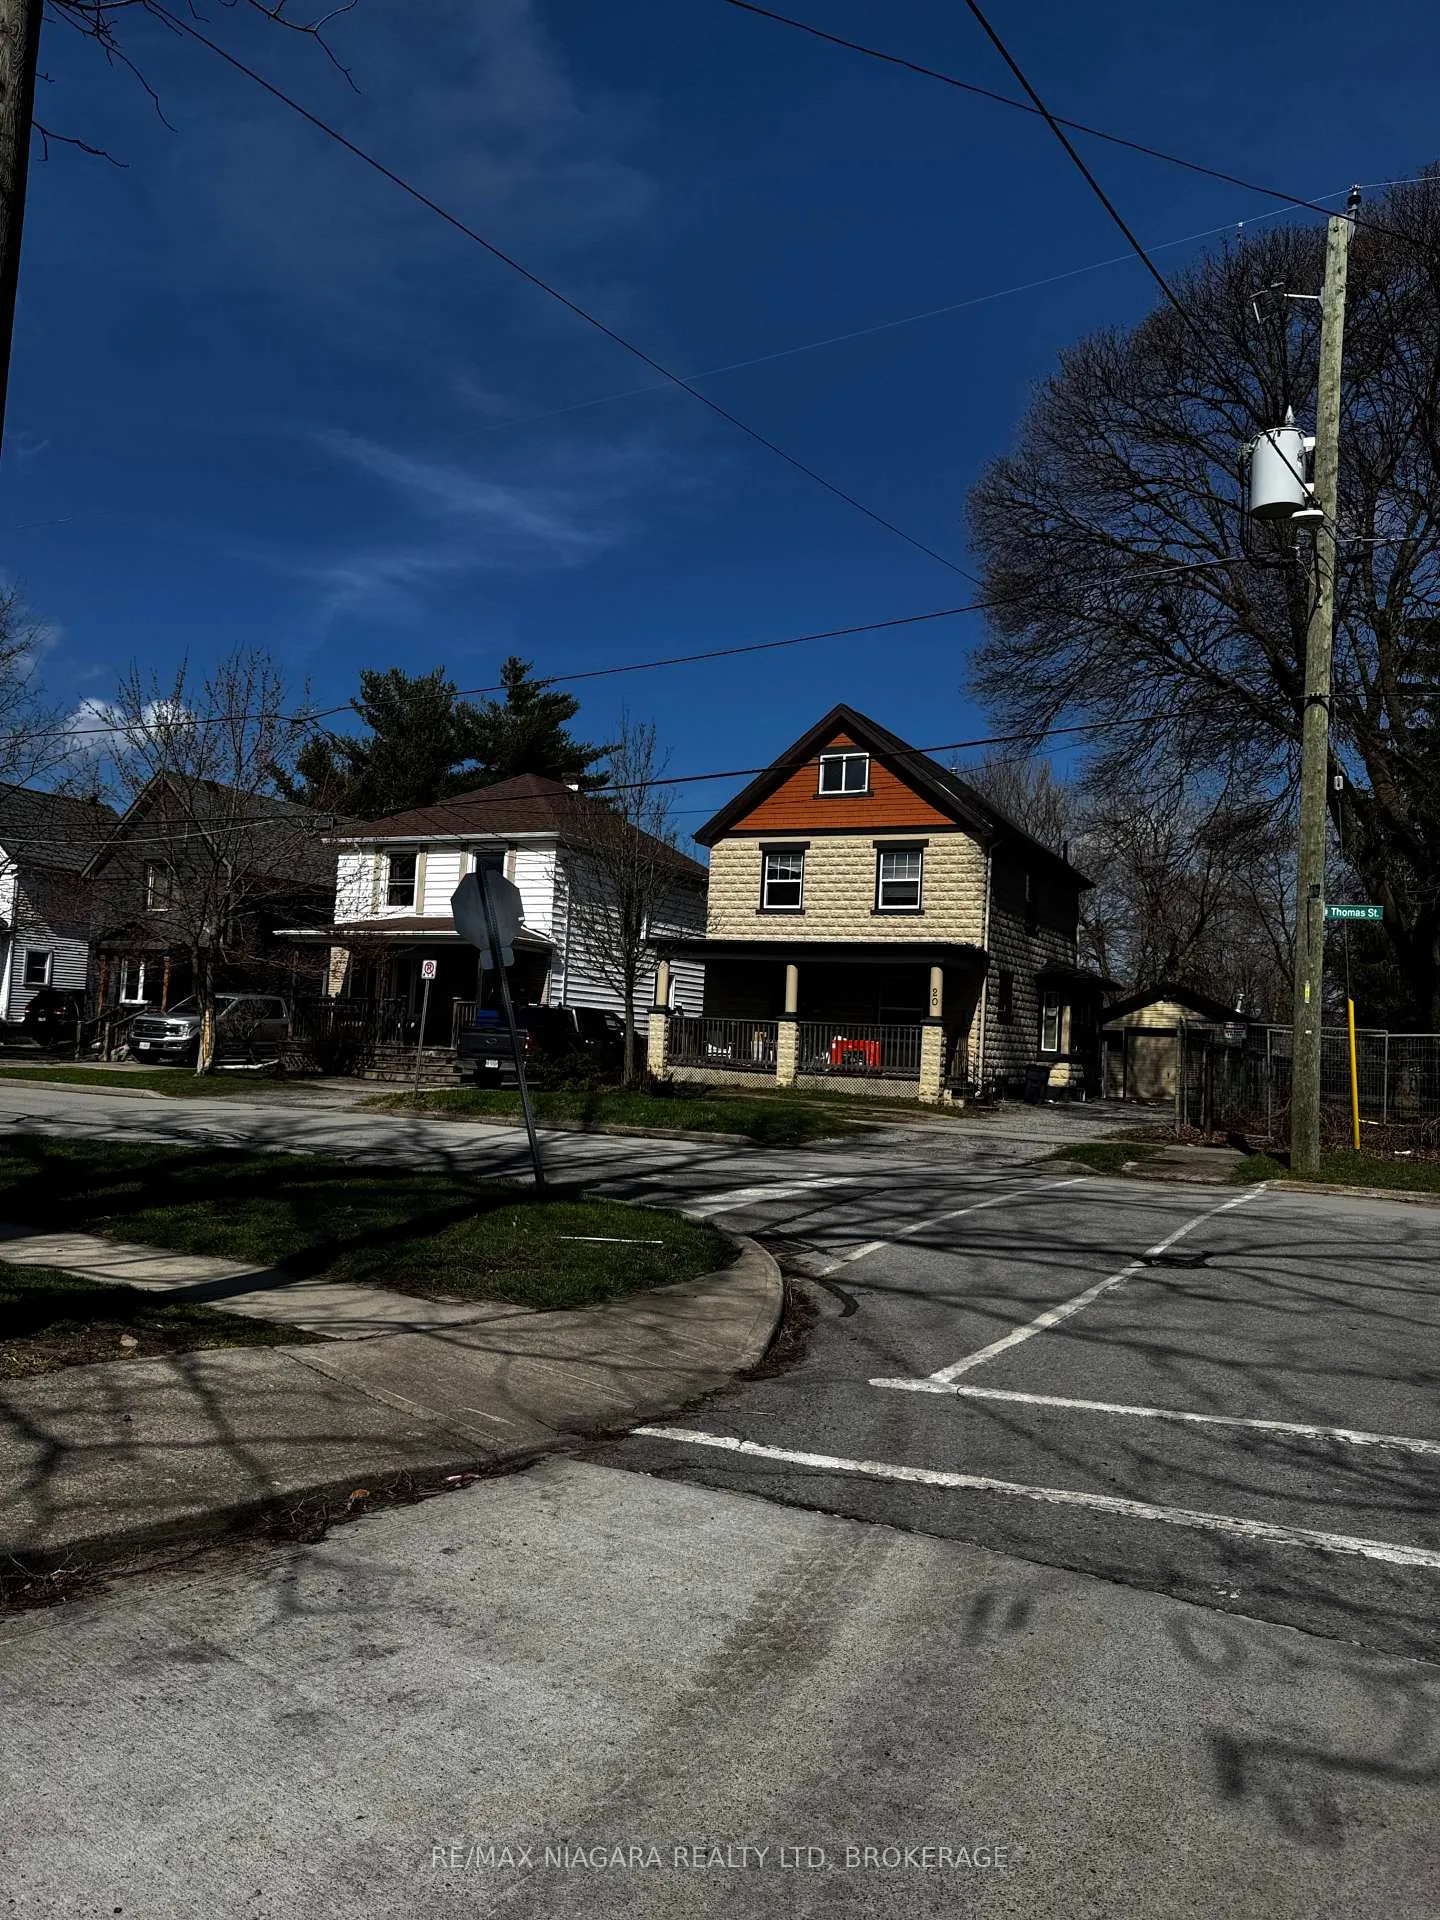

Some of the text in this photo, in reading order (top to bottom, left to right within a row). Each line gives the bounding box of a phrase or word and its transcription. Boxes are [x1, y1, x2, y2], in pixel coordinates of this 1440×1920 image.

[1331, 907, 1380, 918] Thomas St.
[932, 987, 939, 1006] 20
